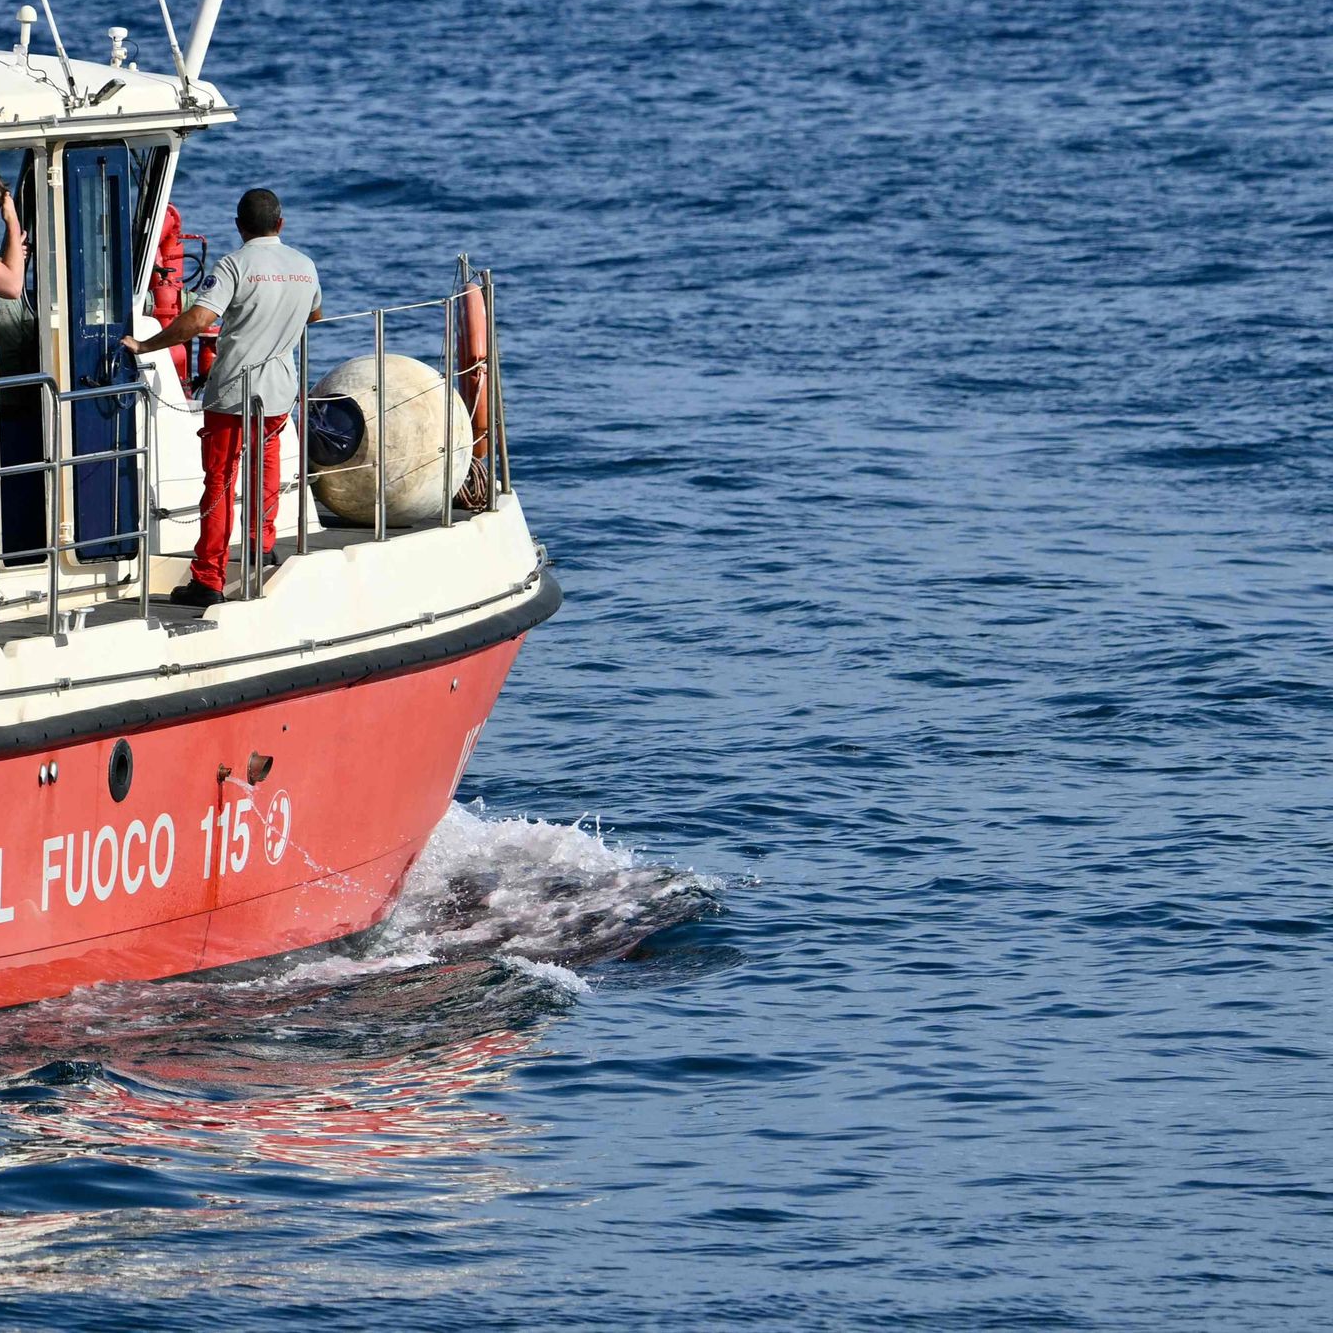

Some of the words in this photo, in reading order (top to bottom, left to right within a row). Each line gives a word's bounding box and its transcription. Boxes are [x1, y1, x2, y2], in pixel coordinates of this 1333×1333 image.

[247, 274, 270, 283] VIGILI
[272, 274, 286, 282] DEL
[289, 274, 313, 284] FUOCO
[41, 812, 175, 911] FUOCO
[201, 798, 252, 880] 115
